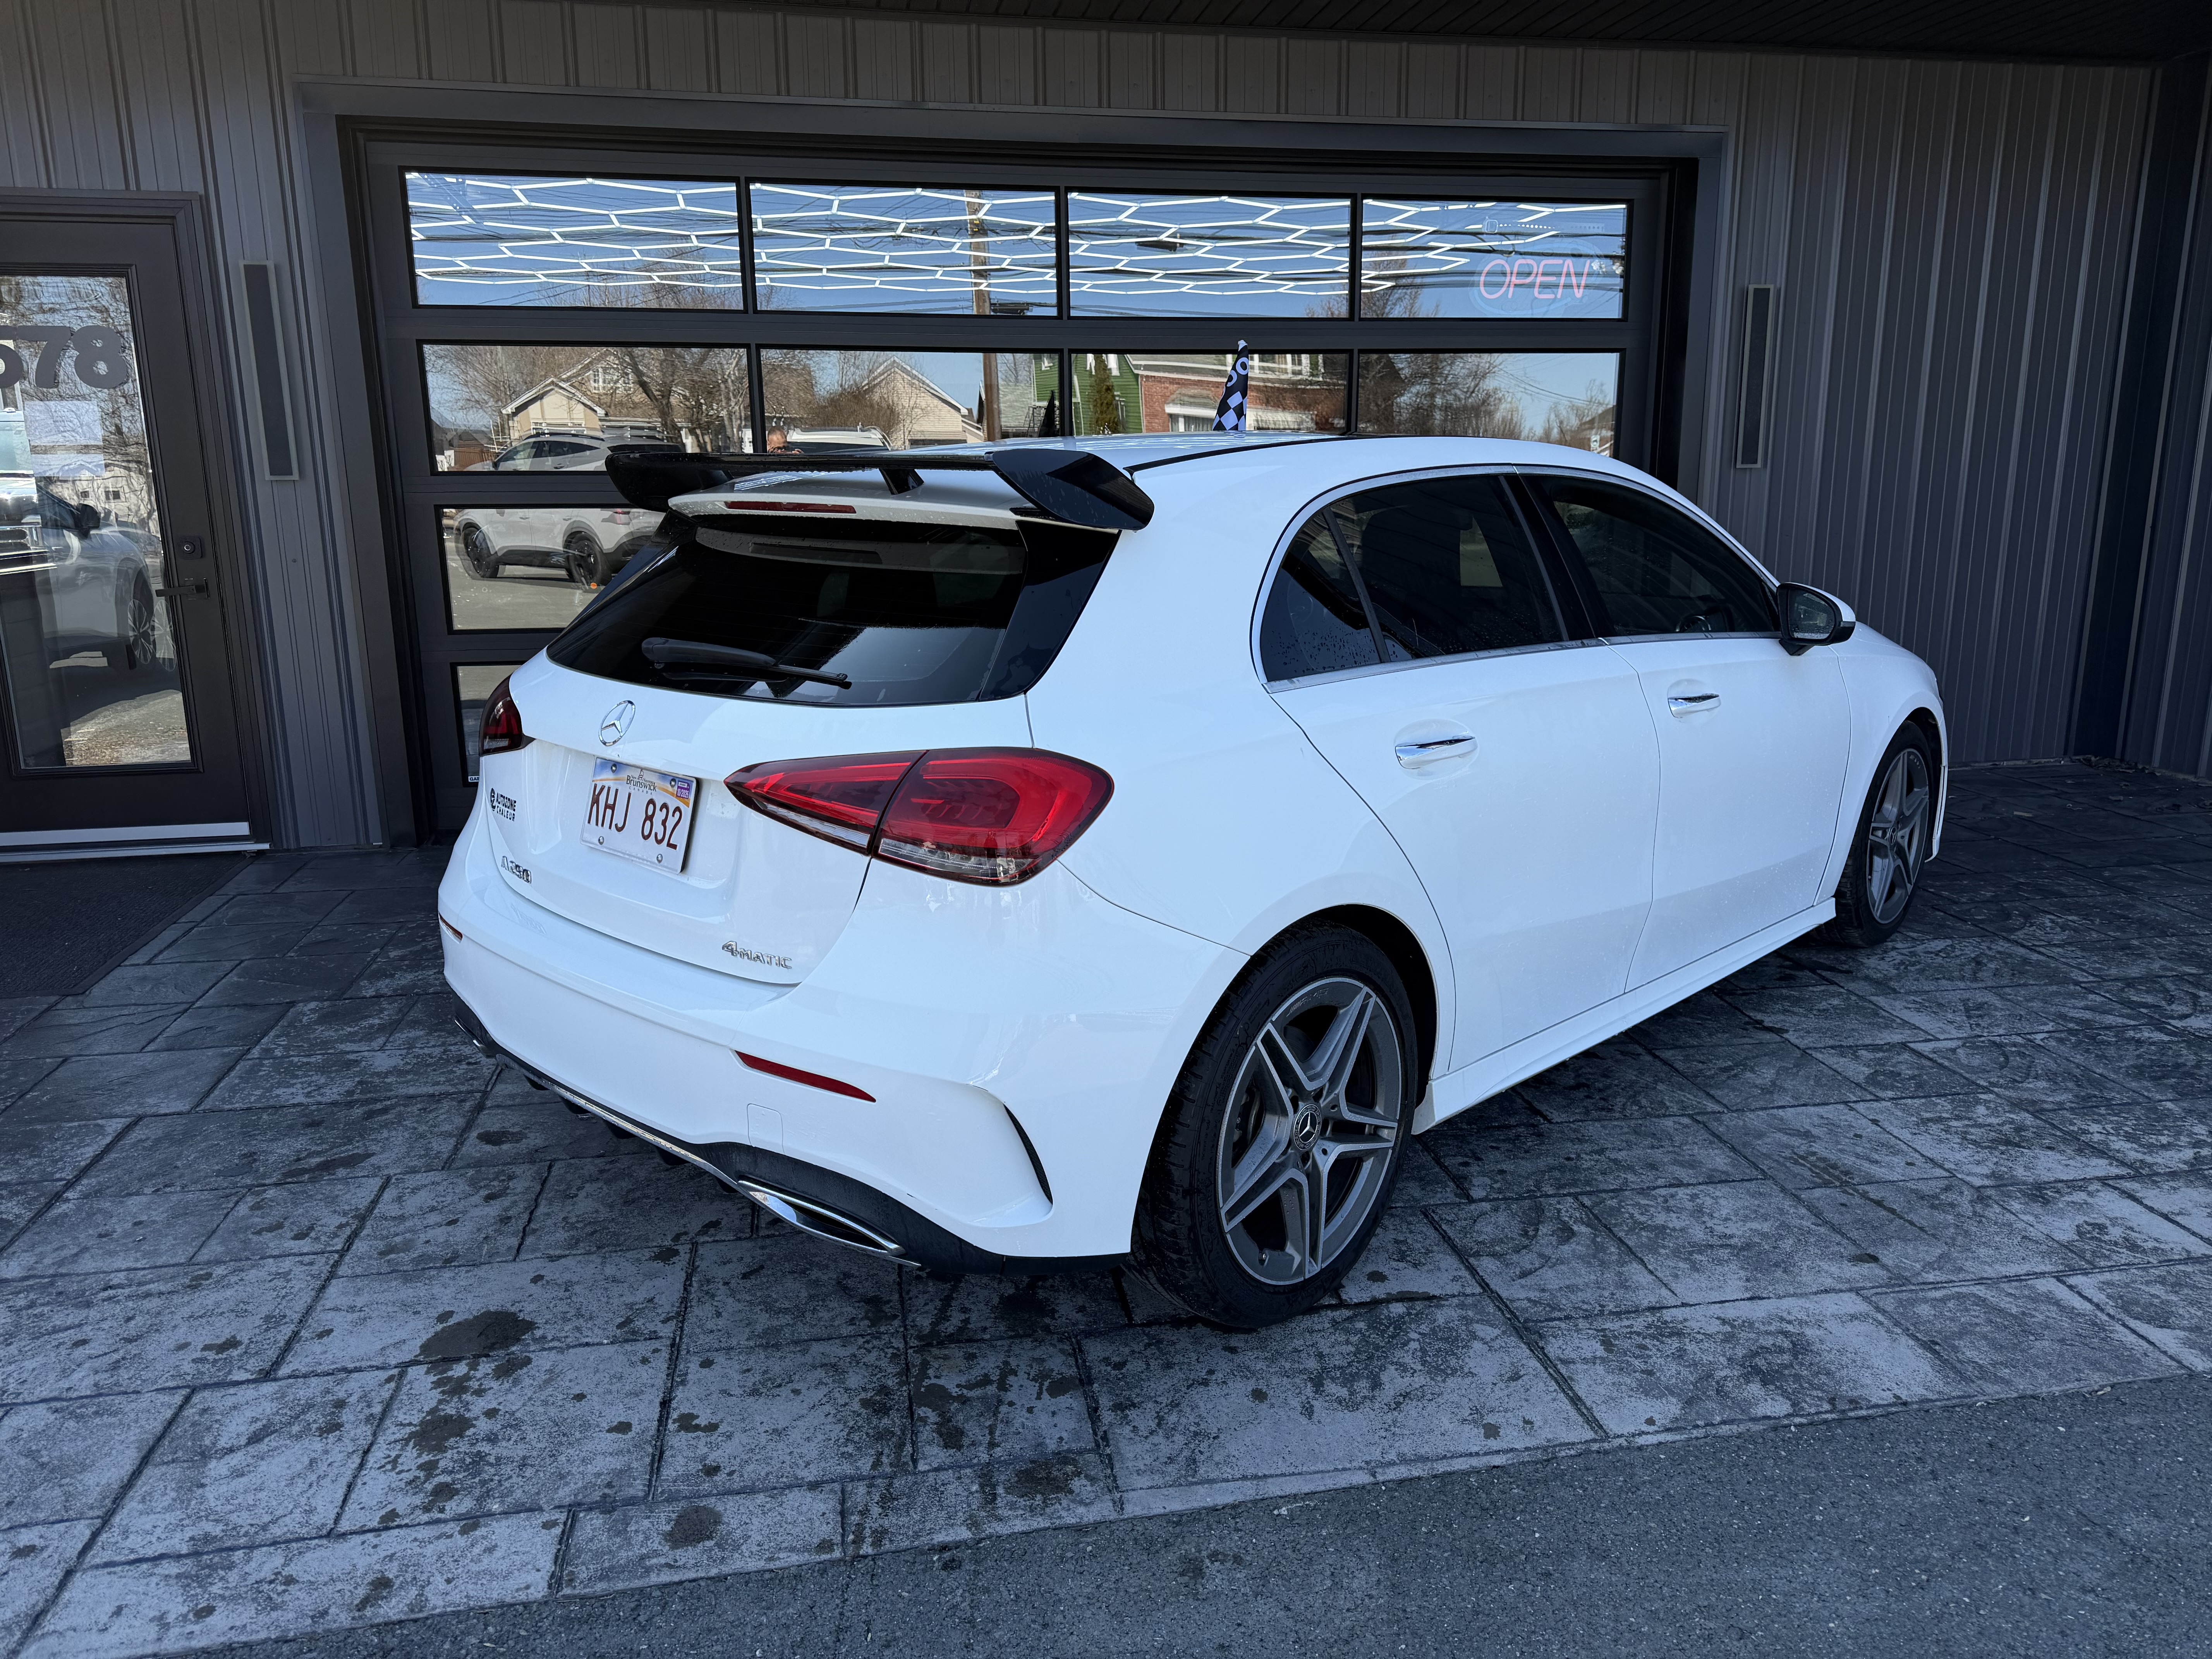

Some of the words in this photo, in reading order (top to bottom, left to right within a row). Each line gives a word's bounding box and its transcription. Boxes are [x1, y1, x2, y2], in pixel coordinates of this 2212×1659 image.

[1480, 259, 1590, 299] OPEN
[626, 775, 657, 792] Brunswick
[629, 786, 653, 795] CANADA
[496, 792, 517, 812] AUTOZONE
[497, 805, 515, 822] CHALEUR
[587, 783, 632, 832] KHJ
[641, 798, 682, 850] 832
[721, 940, 792, 969] 4MATIC
